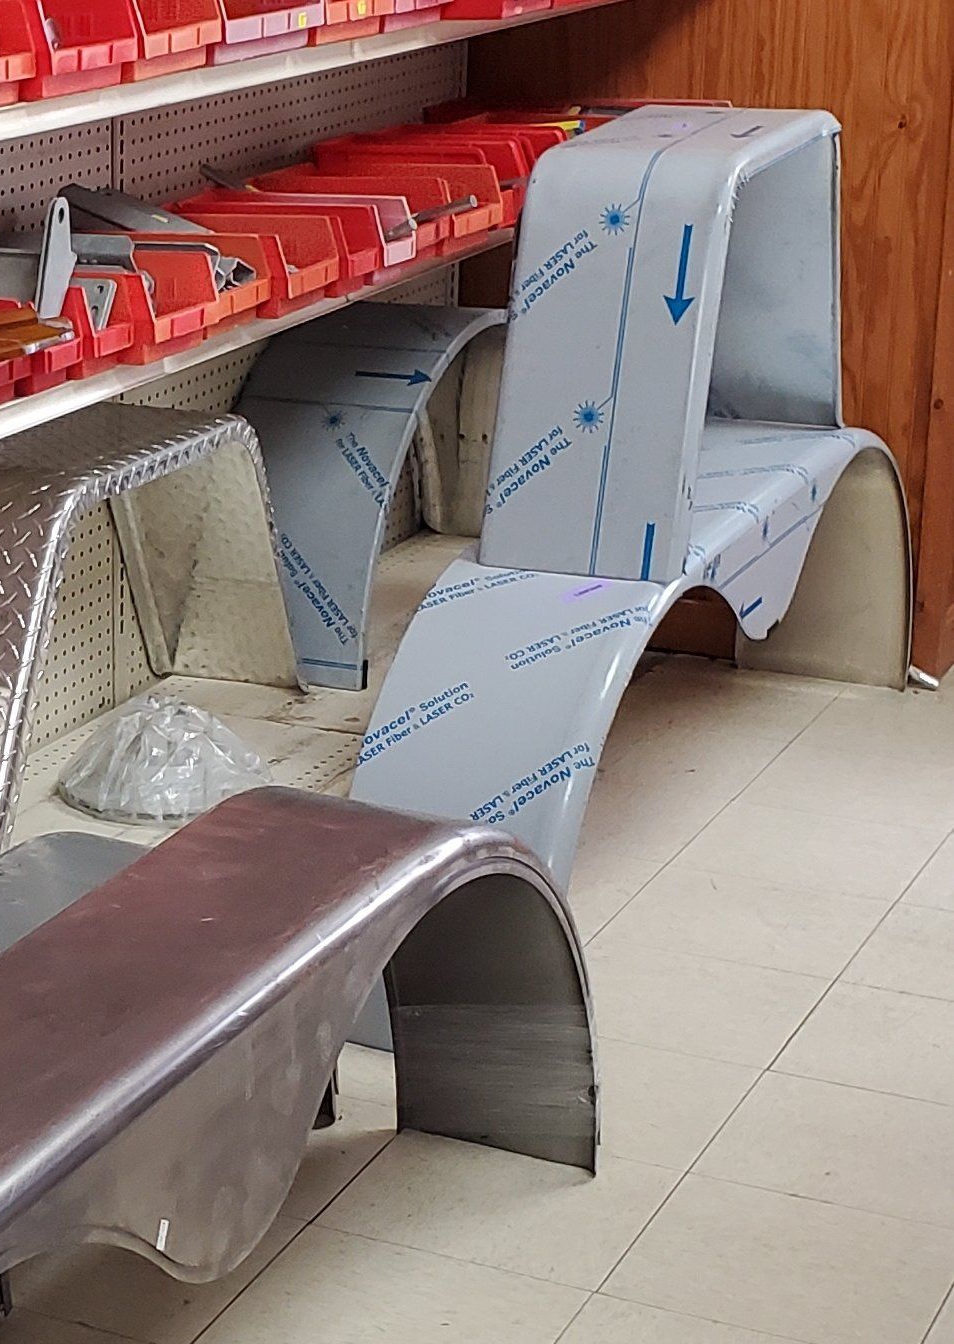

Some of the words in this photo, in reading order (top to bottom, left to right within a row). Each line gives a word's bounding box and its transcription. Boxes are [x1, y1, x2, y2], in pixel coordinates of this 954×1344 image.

[574, 230, 588, 244] for
[544, 242, 574, 270] LASER
[575, 241, 598, 259] The
[521, 268, 544, 291] Fiber
[548, 426, 563, 441] for
[519, 438, 549, 466] LASER
[550, 438, 572, 455] The
[342, 448, 361, 472] LASER
[496, 463, 520, 485] Fiber
[290, 548, 310, 574] LASER
[313, 580, 329, 600] Fiber
[417, 597, 447, 611] ASER
[449, 589, 474, 600] Fiber
[484, 577, 517, 589] LASER
[327, 599, 349, 626] LASER
[599, 609, 633, 624] LASER
[334, 627, 348, 645] The
[571, 622, 596, 634] Fiber
[527, 635, 561, 652] LASER
[511, 646, 561, 669] Solution
[419, 683, 468, 711] Solution
[385, 727, 411, 746] Fiber
[420, 703, 453, 725] LASER
[573, 743, 590, 754] for
[538, 751, 573, 776] LASER
[573, 756, 595, 769] The
[512, 773, 538, 793] Fiber
[470, 795, 504, 820] LASER
